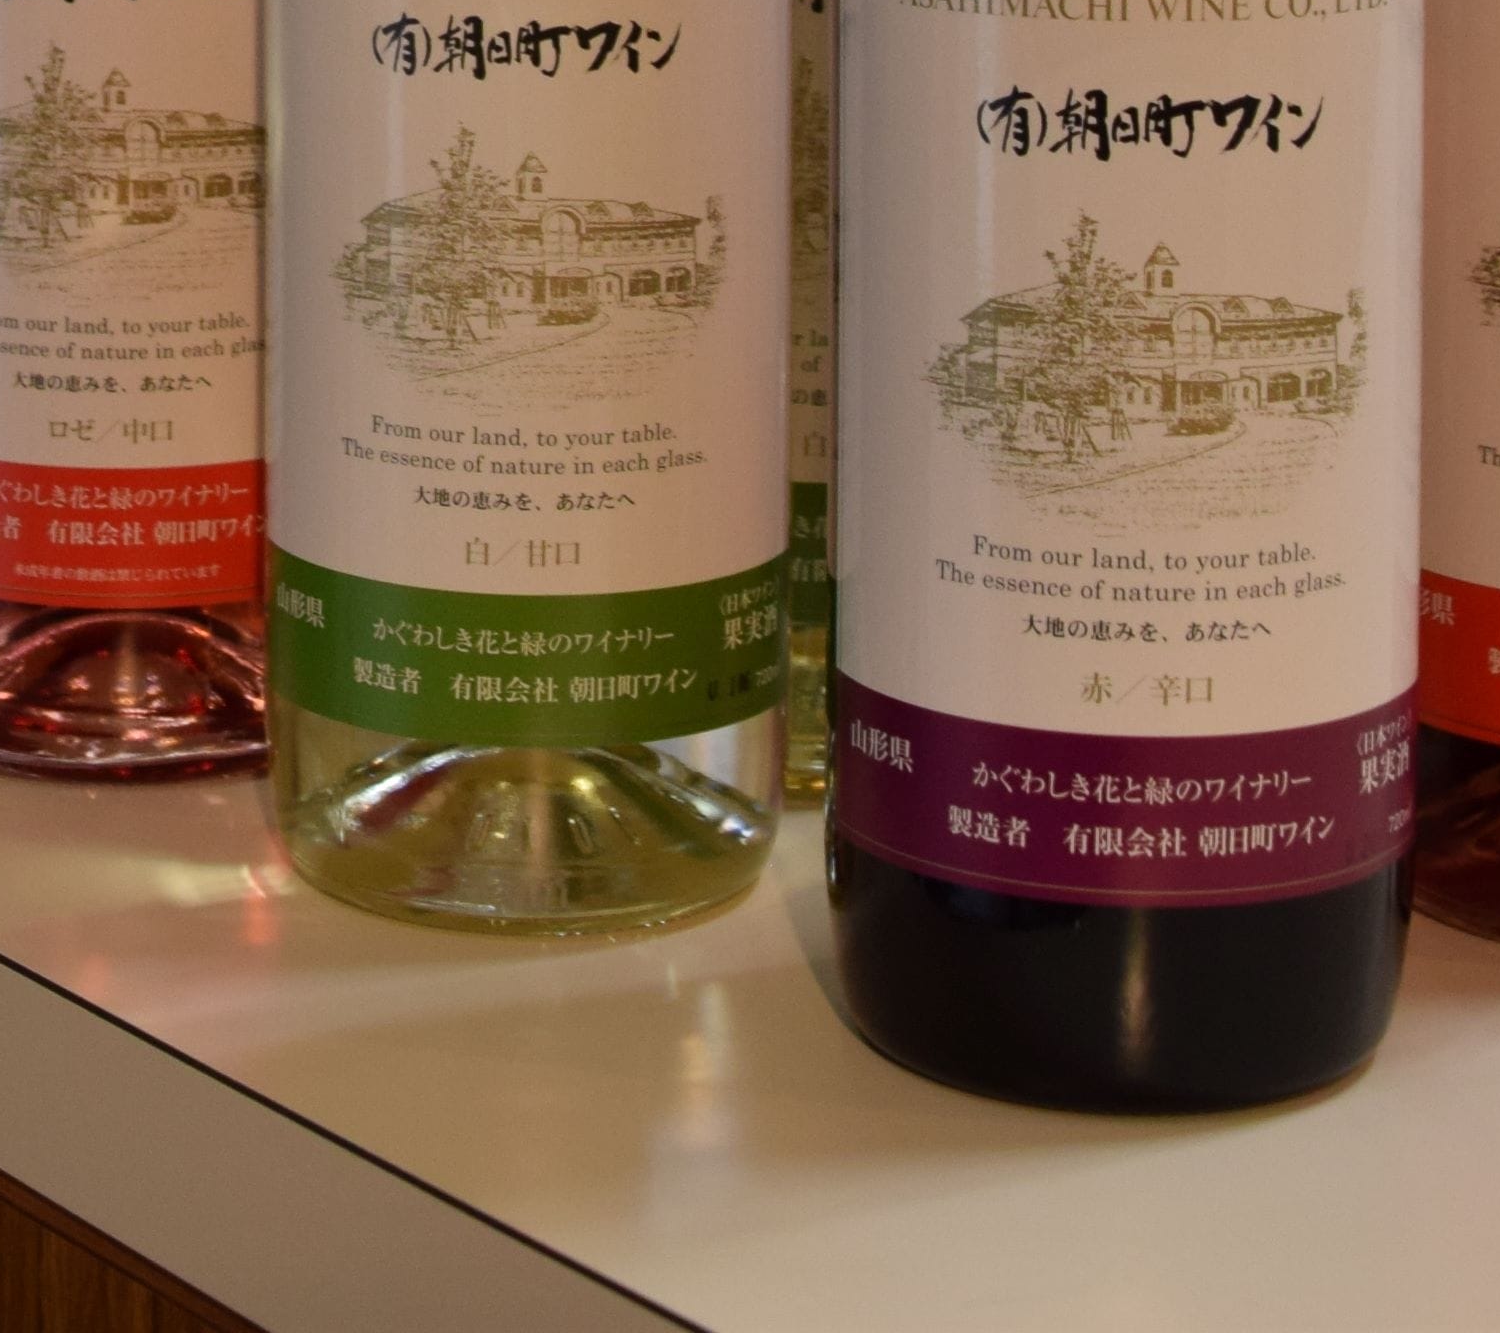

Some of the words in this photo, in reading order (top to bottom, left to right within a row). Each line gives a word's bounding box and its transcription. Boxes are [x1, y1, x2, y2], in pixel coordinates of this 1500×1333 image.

[371, 414, 423, 442] From
[428, 425, 465, 445] our
[472, 426, 530, 451] land,
[536, 428, 560, 448] to
[564, 429, 617, 452] your
[620, 421, 678, 444] table.
[340, 436, 376, 462] The
[378, 449, 457, 473] essence
[462, 453, 487, 475] of
[491, 456, 567, 477] nature
[573, 455, 596, 476] in
[601, 452, 652, 475] each
[655, 448, 709, 476] glass.
[46, 519, 145, 546] 有限会社
[972, 534, 1033, 565] From
[1041, 546, 1084, 568] our
[1091, 547, 1156, 575] land,
[1163, 551, 1188, 572] to
[1195, 550, 1251, 577] your
[1257, 542, 1317, 567] table.
[934, 558, 977, 587] The
[981, 571, 1073, 600] essence
[1079, 579, 1104, 601] of
[1110, 582, 1198, 603] nature
[1204, 580, 1229, 602] in
[1235, 576, 1288, 599] each
[1292, 568, 1347, 599] glass.
[372, 617, 676, 657] かぐわしき花と緑のワイナリー
[352, 656, 423, 696] 製造者
[449, 673, 559, 705] 有限会社
[568, 668, 698, 702] 朝日町ワイン
[849, 718, 914, 774] 山形県
[971, 760, 1313, 807] かぐわしき花と緑のワイナリー
[947, 805, 1031, 850] 製造者
[1062, 823, 1188, 860] 有限会社
[1199, 814, 1335, 858] 朝日町ワイン
